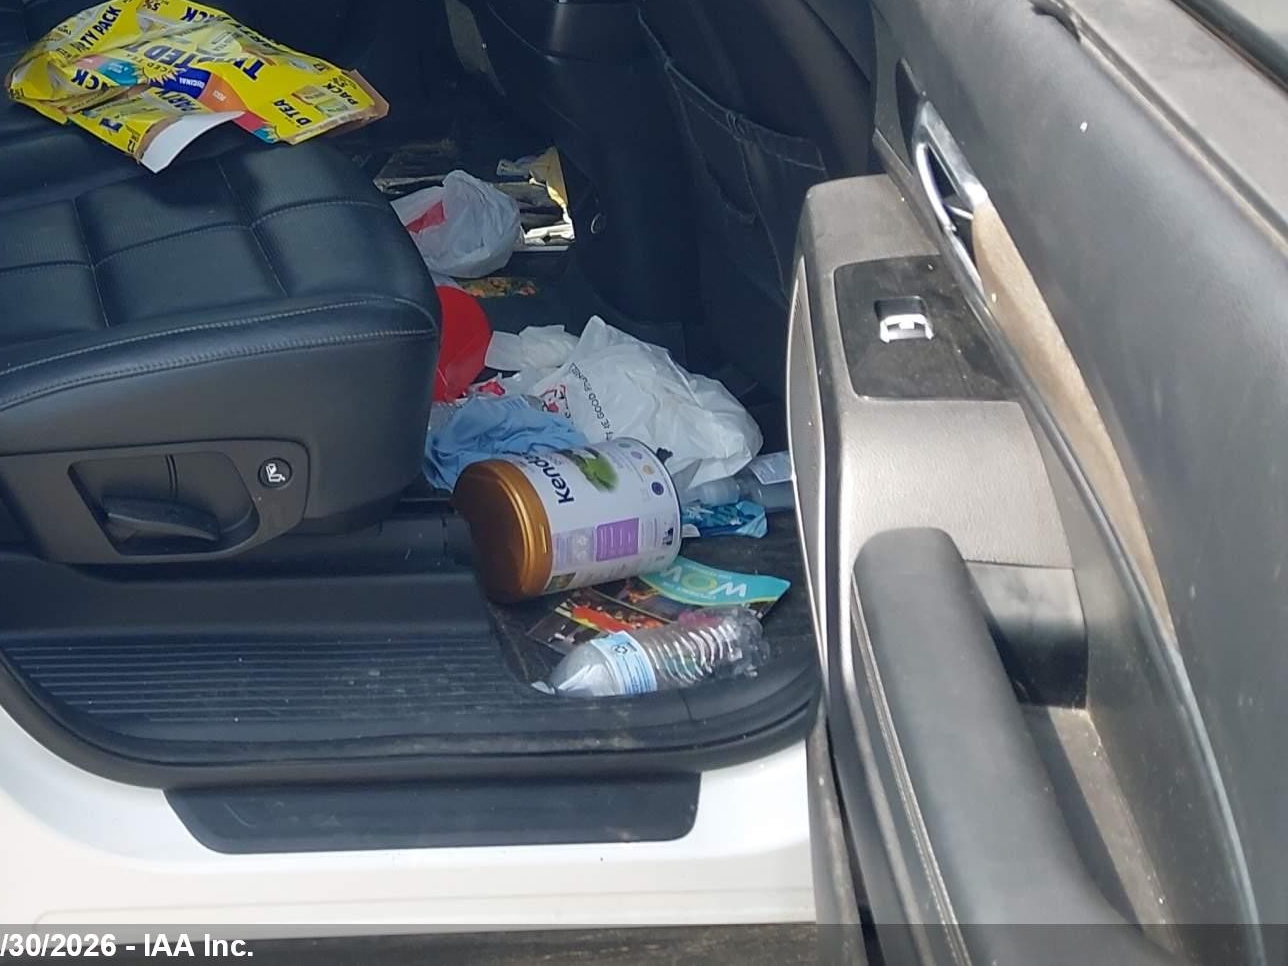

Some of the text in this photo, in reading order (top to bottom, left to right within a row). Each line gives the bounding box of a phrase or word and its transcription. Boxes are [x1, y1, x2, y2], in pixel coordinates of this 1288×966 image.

[92, 4, 122, 36] PACK
[322, 82, 359, 106] PACK
[273, 99, 300, 118] TEA
[588, 392, 605, 420] GOOD
